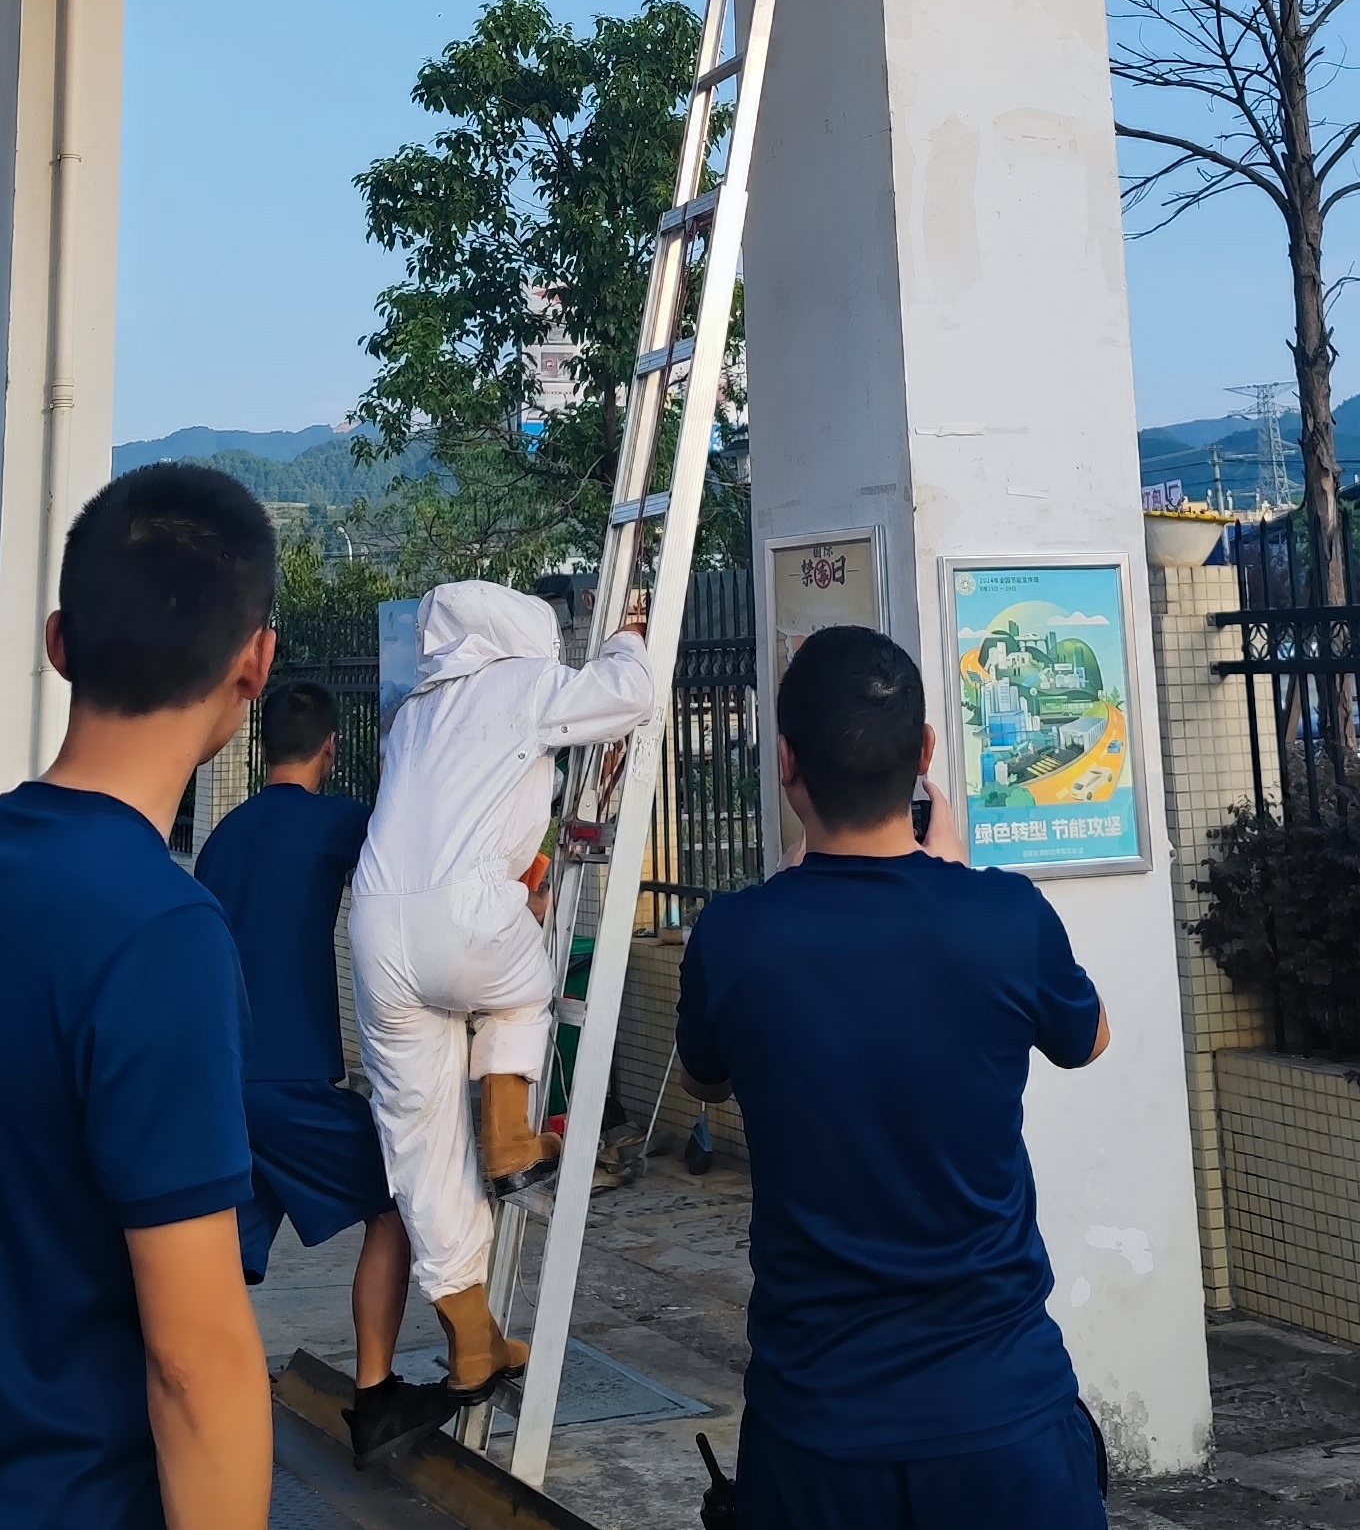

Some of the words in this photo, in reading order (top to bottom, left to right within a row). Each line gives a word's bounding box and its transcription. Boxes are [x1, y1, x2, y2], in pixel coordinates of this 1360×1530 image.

[801, 555, 847, 589] 禁毒日
[973, 820, 1048, 845] 绿色转型
[1050, 815, 1122, 840] 节能攻坚
